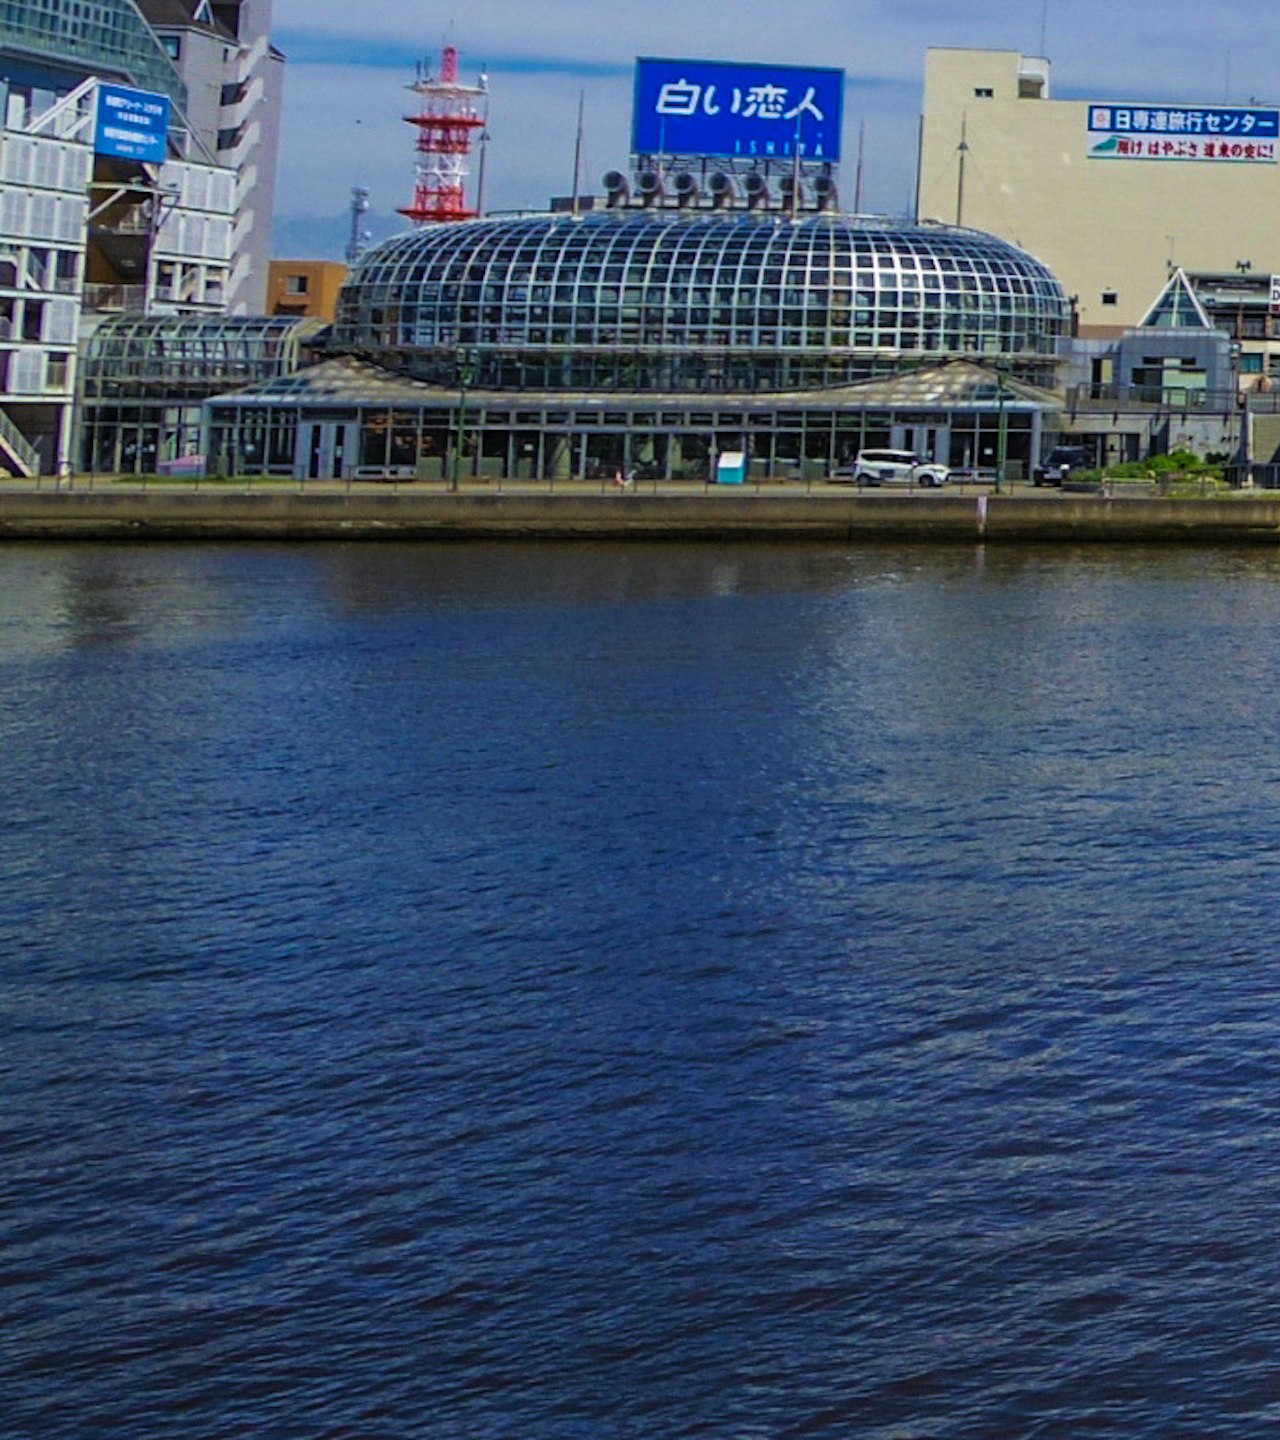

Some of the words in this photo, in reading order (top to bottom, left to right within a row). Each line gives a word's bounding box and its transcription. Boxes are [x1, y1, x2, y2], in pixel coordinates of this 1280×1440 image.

[655, 78, 824, 121] 白い恋人
[1115, 110, 1274, 133] 日専連旅行センター
[735, 139, 823, 156] ISHIYA
[1148, 141, 1198, 157] はやぶさ
